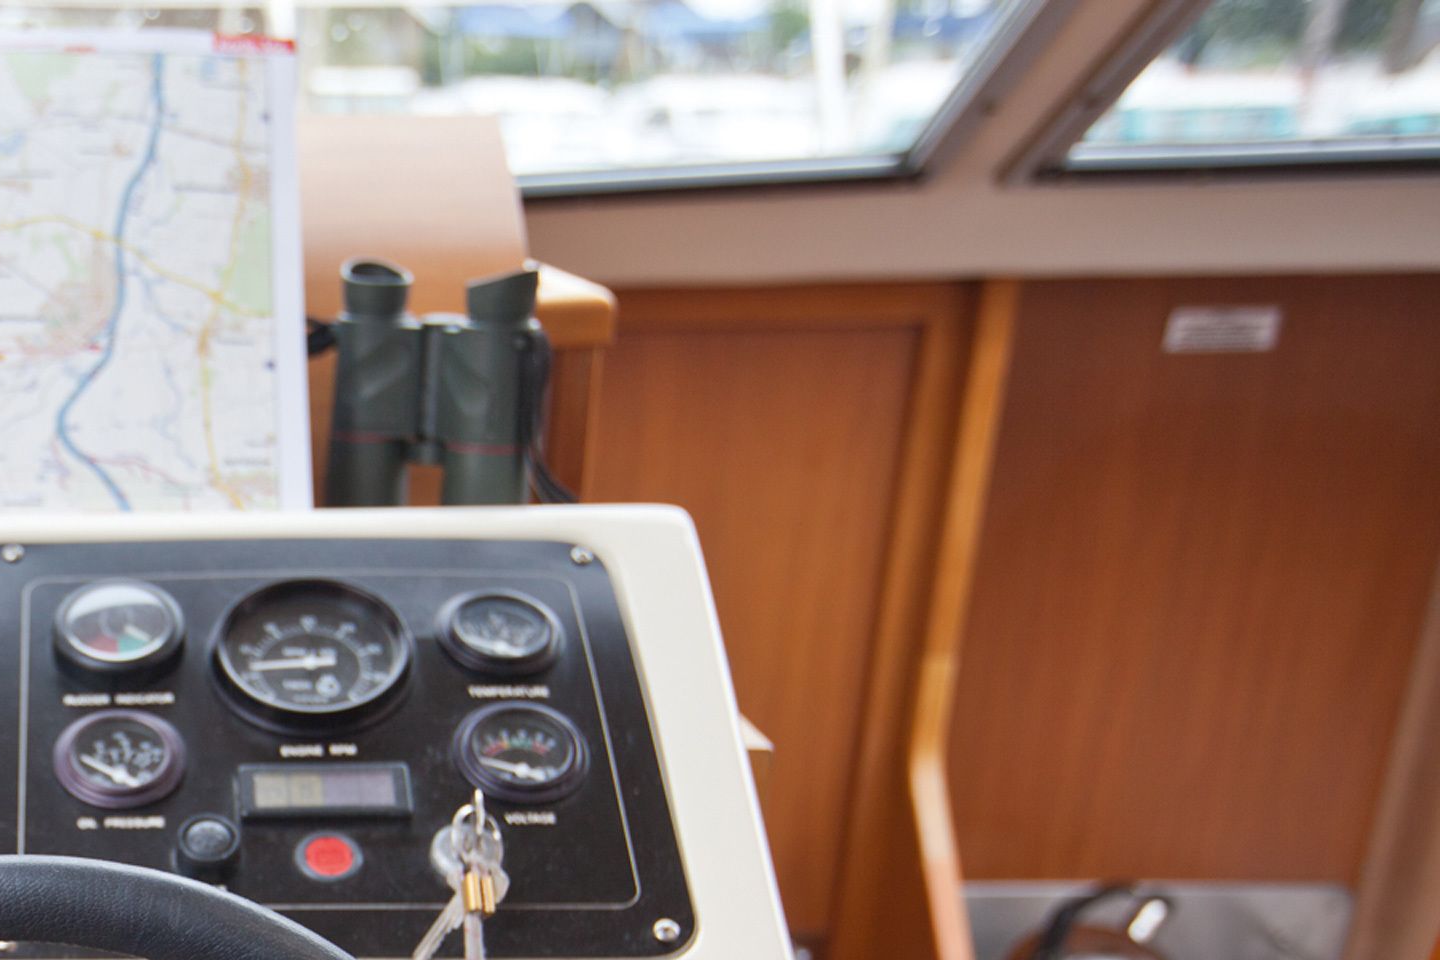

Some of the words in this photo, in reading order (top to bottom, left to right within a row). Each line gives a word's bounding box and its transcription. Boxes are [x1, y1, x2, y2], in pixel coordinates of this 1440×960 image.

[114, 691, 175, 705] INDICATOR
[468, 685, 550, 698] TEMPERATURE
[279, 744, 324, 757] ENGINE
[328, 743, 358, 756] RPM
[76, 817, 98, 830] OIL
[103, 815, 166, 829] PRESSURE
[504, 812, 557, 825] VOLTAGE
